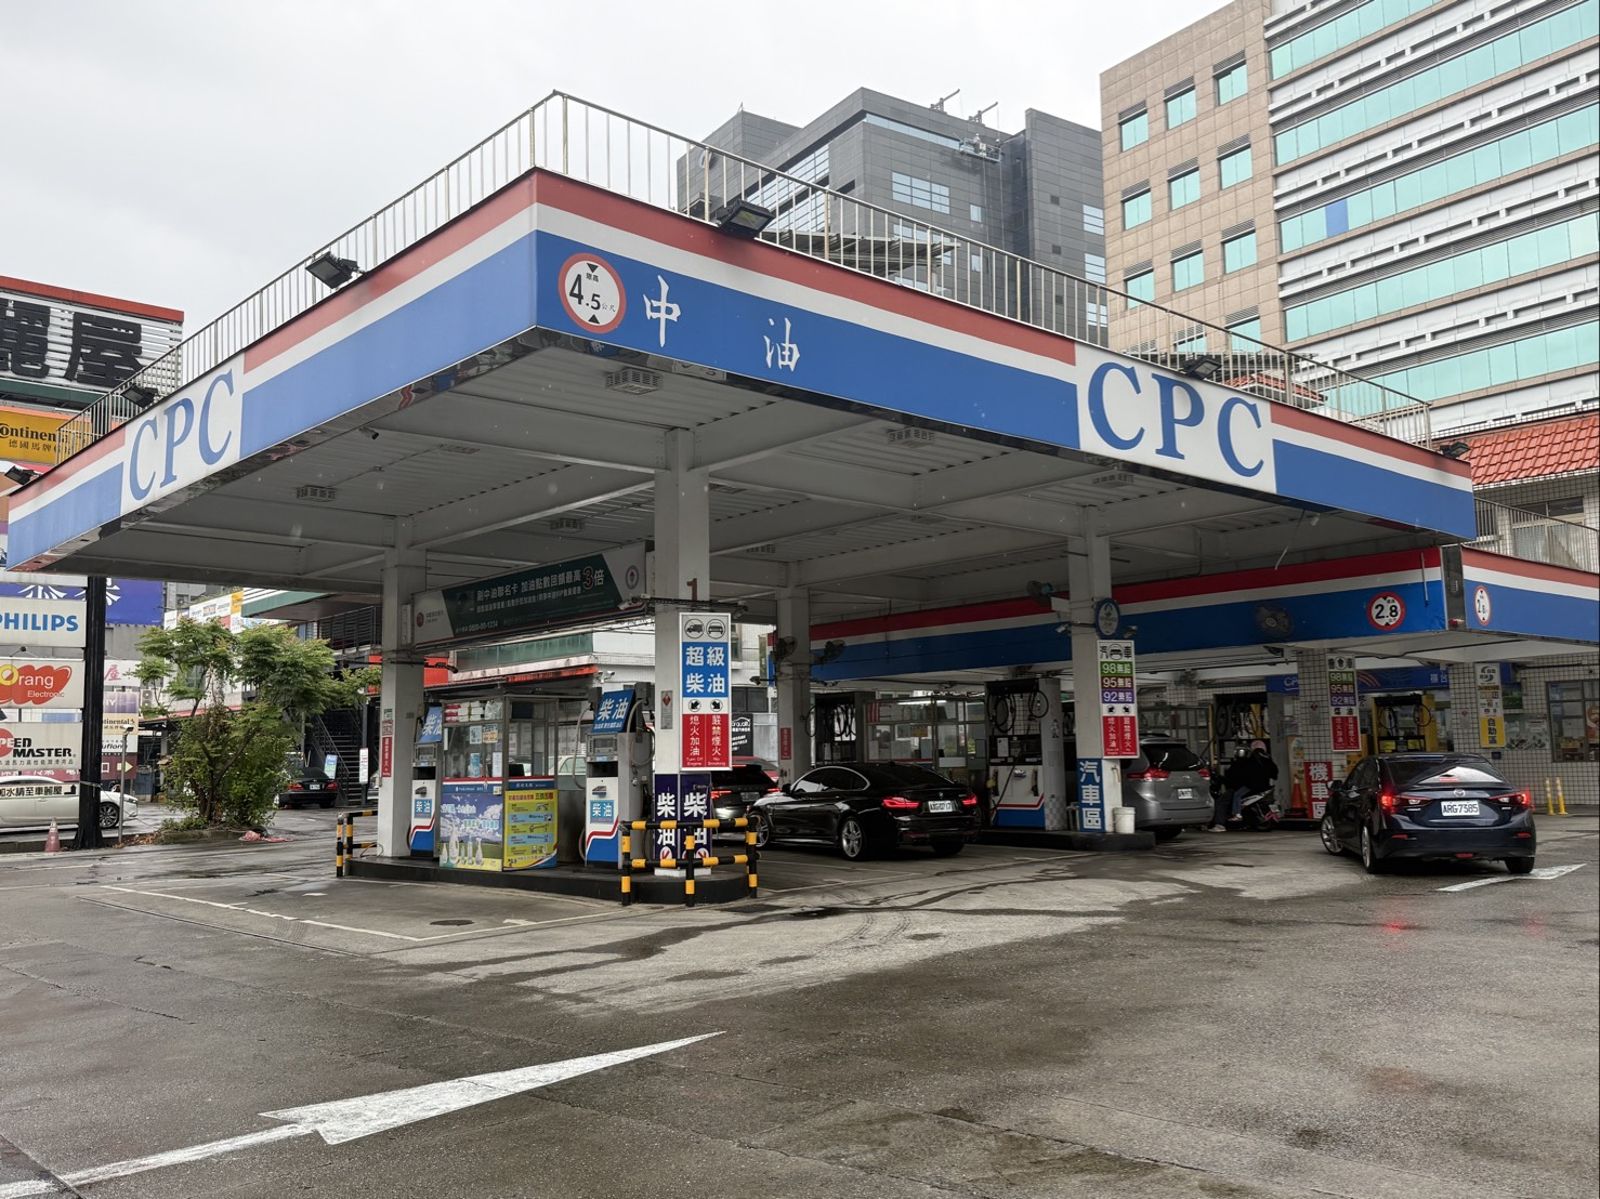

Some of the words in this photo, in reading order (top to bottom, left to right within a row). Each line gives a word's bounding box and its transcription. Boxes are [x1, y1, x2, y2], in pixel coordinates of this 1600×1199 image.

[569, 273, 601, 311] 4.5
[1087, 361, 1265, 478] CPC
[129, 368, 235, 501] CPC
[685, 578, 698, 601] 1
[0, 611, 79, 632] HILIPS
[1374, 603, 1399, 620] 2.8
[685, 645, 726, 668] 超級
[685, 672, 727, 695] 柴油
[597, 697, 629, 721] 柴油
[689, 715, 701, 756] 熄火加油
[12, 748, 72, 758] MASTER
[1079, 760, 1102, 830] 汽車區
[1308, 762, 1330, 819] 機車區
[415, 800, 431, 814] 柴油
[592, 802, 613, 817] 柴油
[656, 792, 676, 847] 柴油
